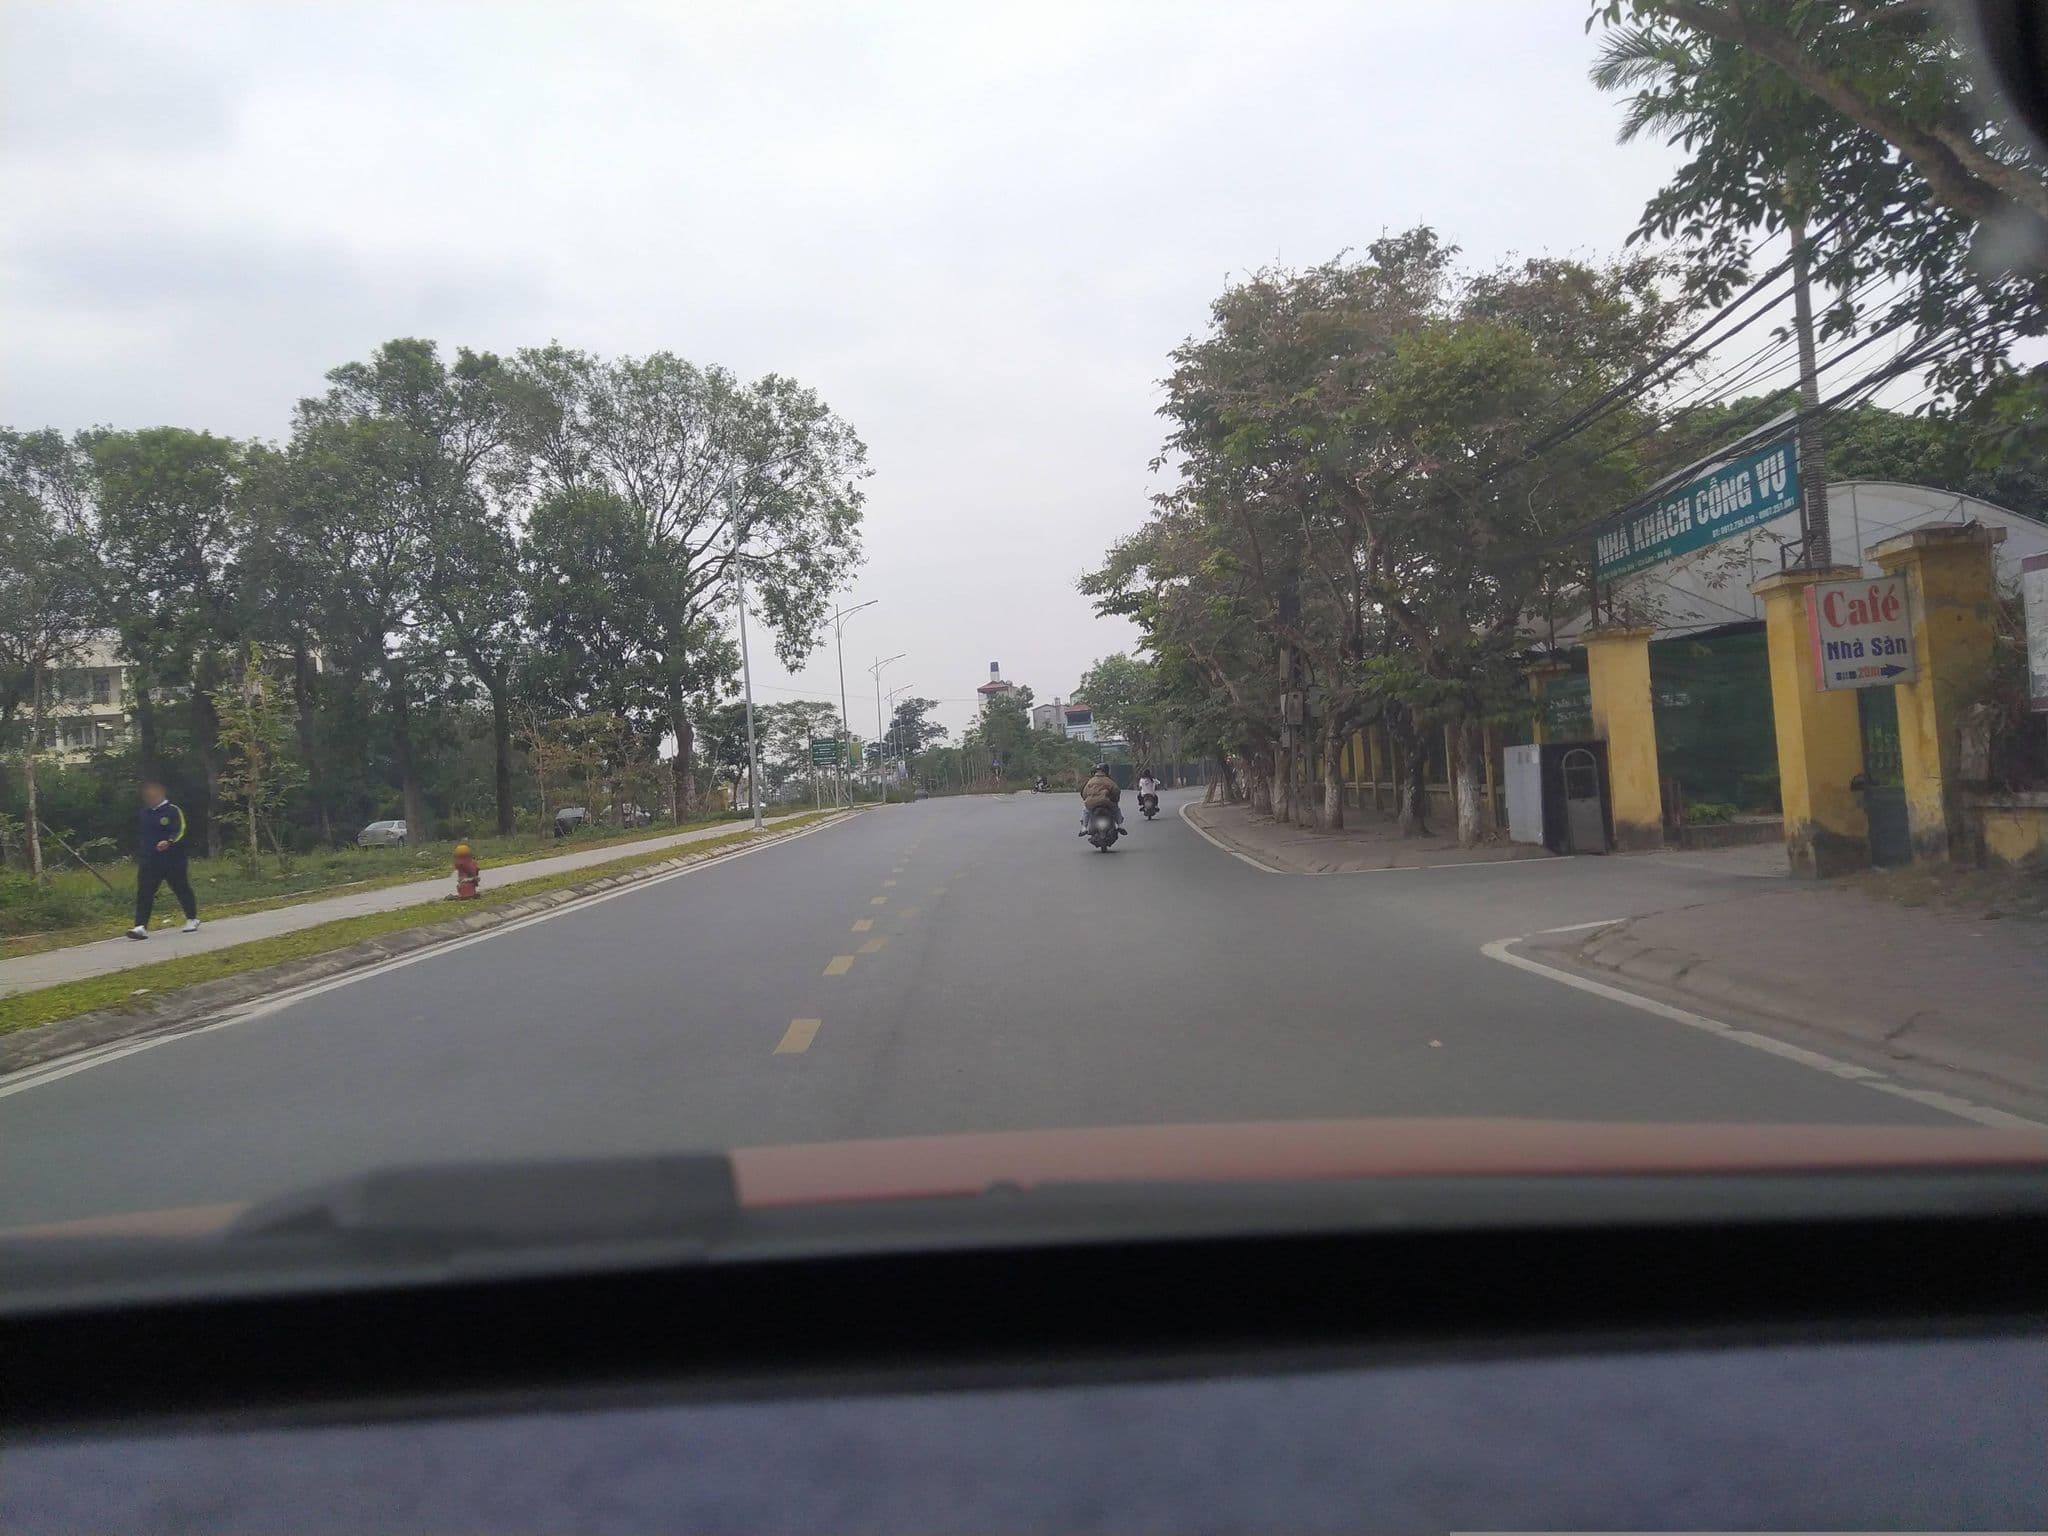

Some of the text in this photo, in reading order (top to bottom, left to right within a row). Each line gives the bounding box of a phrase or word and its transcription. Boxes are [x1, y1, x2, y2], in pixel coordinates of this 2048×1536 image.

[1633, 498, 1692, 552] KHÁCH
[1695, 471, 1752, 526] CÔNG
[1756, 450, 1787, 499] VỤ
[1823, 583, 1900, 628] Café
[1827, 638, 1865, 661] Nhà
